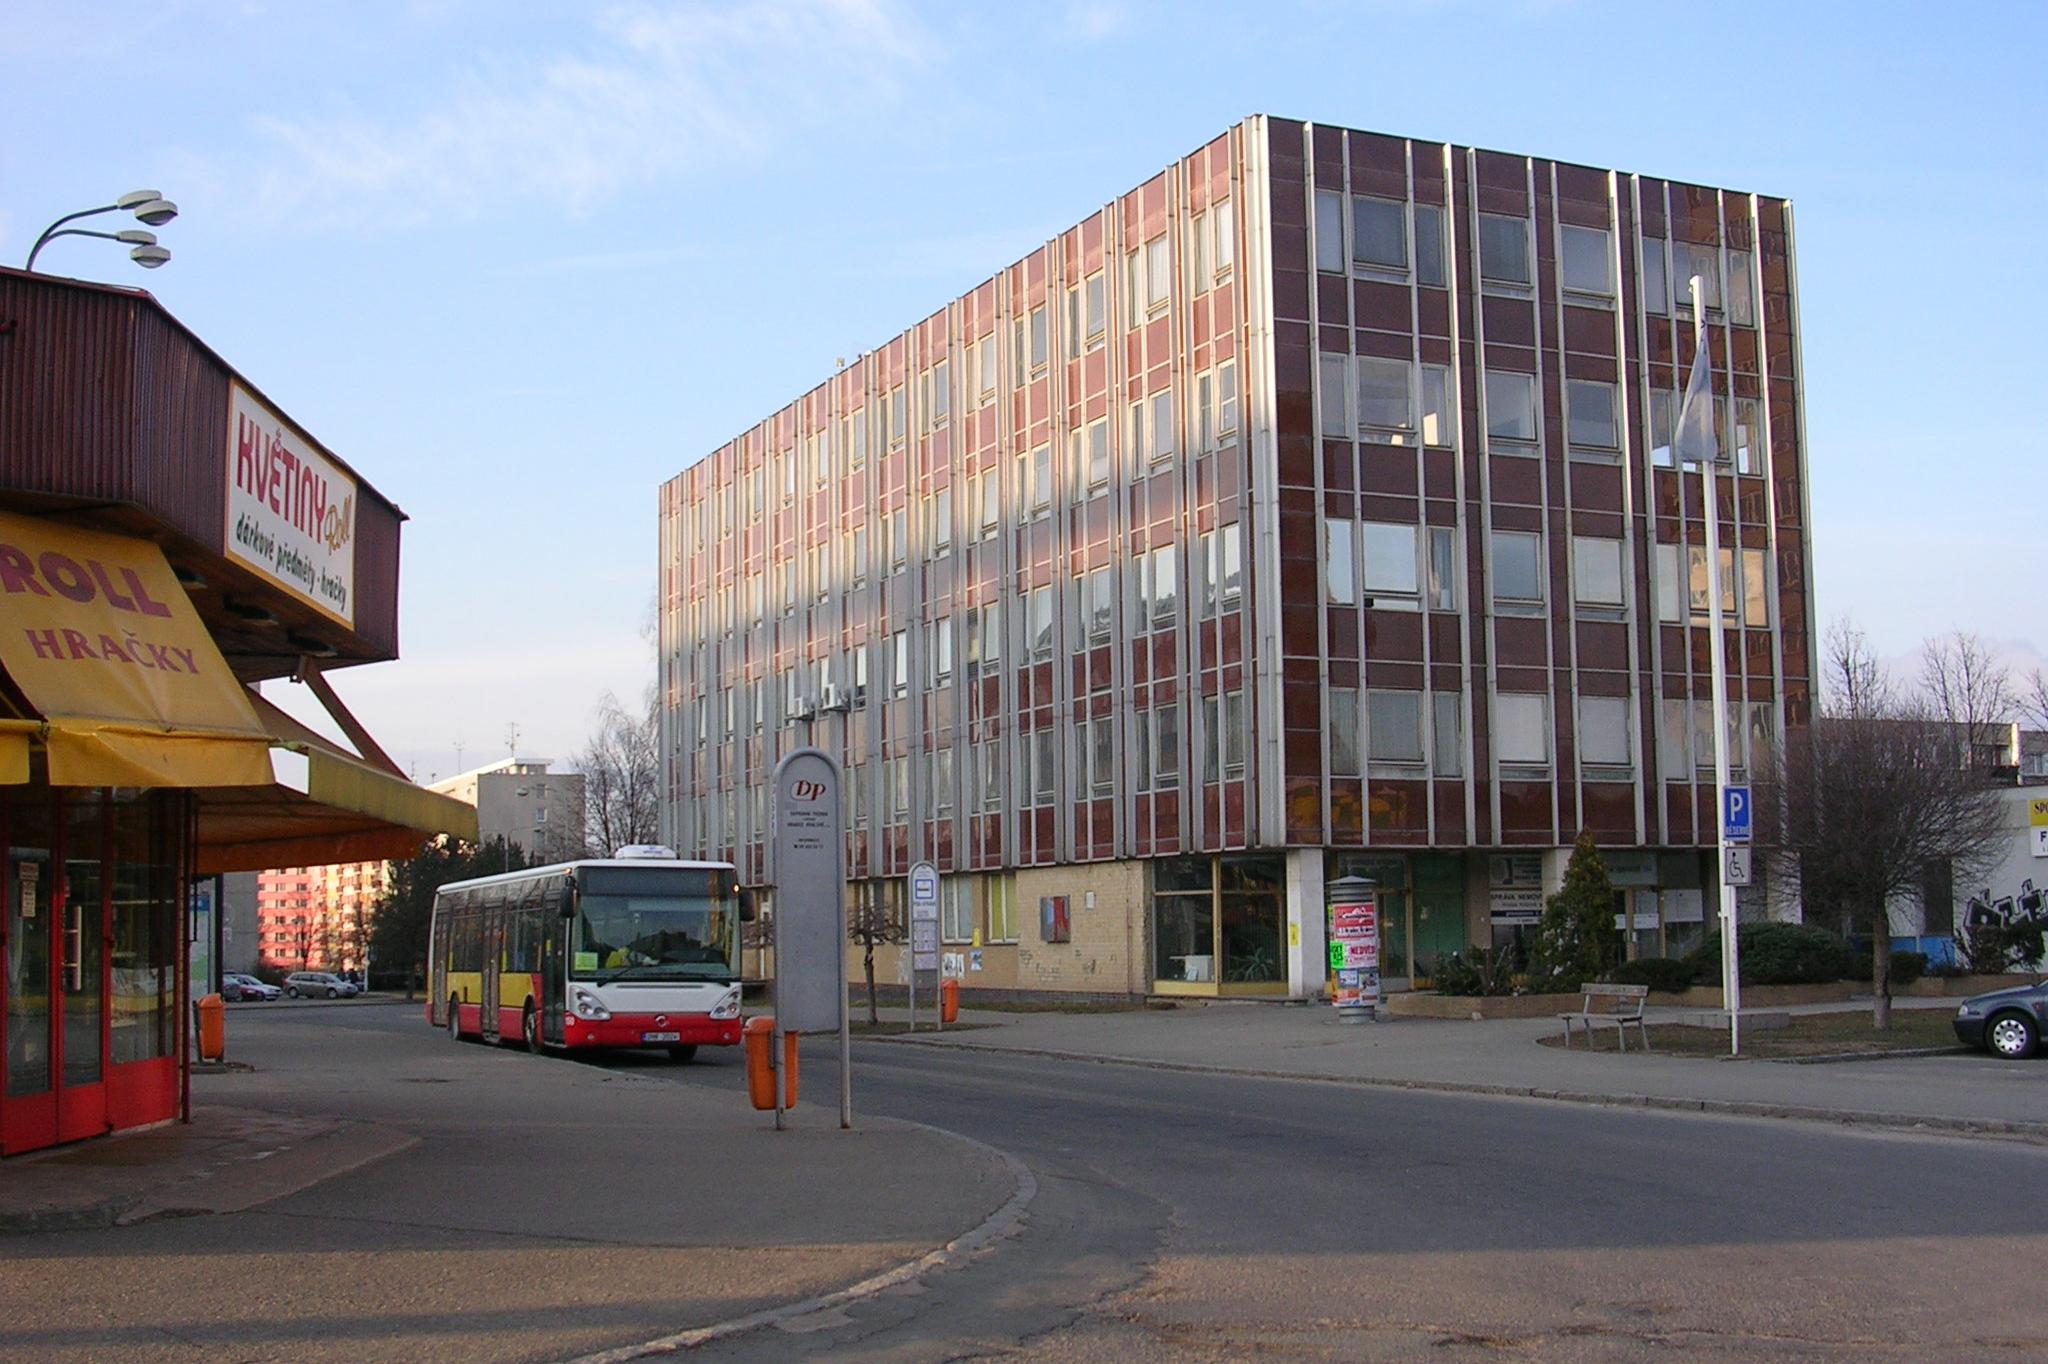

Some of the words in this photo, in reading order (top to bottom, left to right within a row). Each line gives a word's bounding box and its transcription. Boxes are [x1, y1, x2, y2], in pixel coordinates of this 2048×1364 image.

[236, 411, 327, 544] KVĚTINY
[0, 543, 173, 618] ROLL
[236, 511, 275, 561] dárkové
[275, 541, 316, 595] předměty
[320, 565, 347, 612] hračky
[23, 627, 199, 674] HRAČKY
[1730, 792, 1744, 822] P
